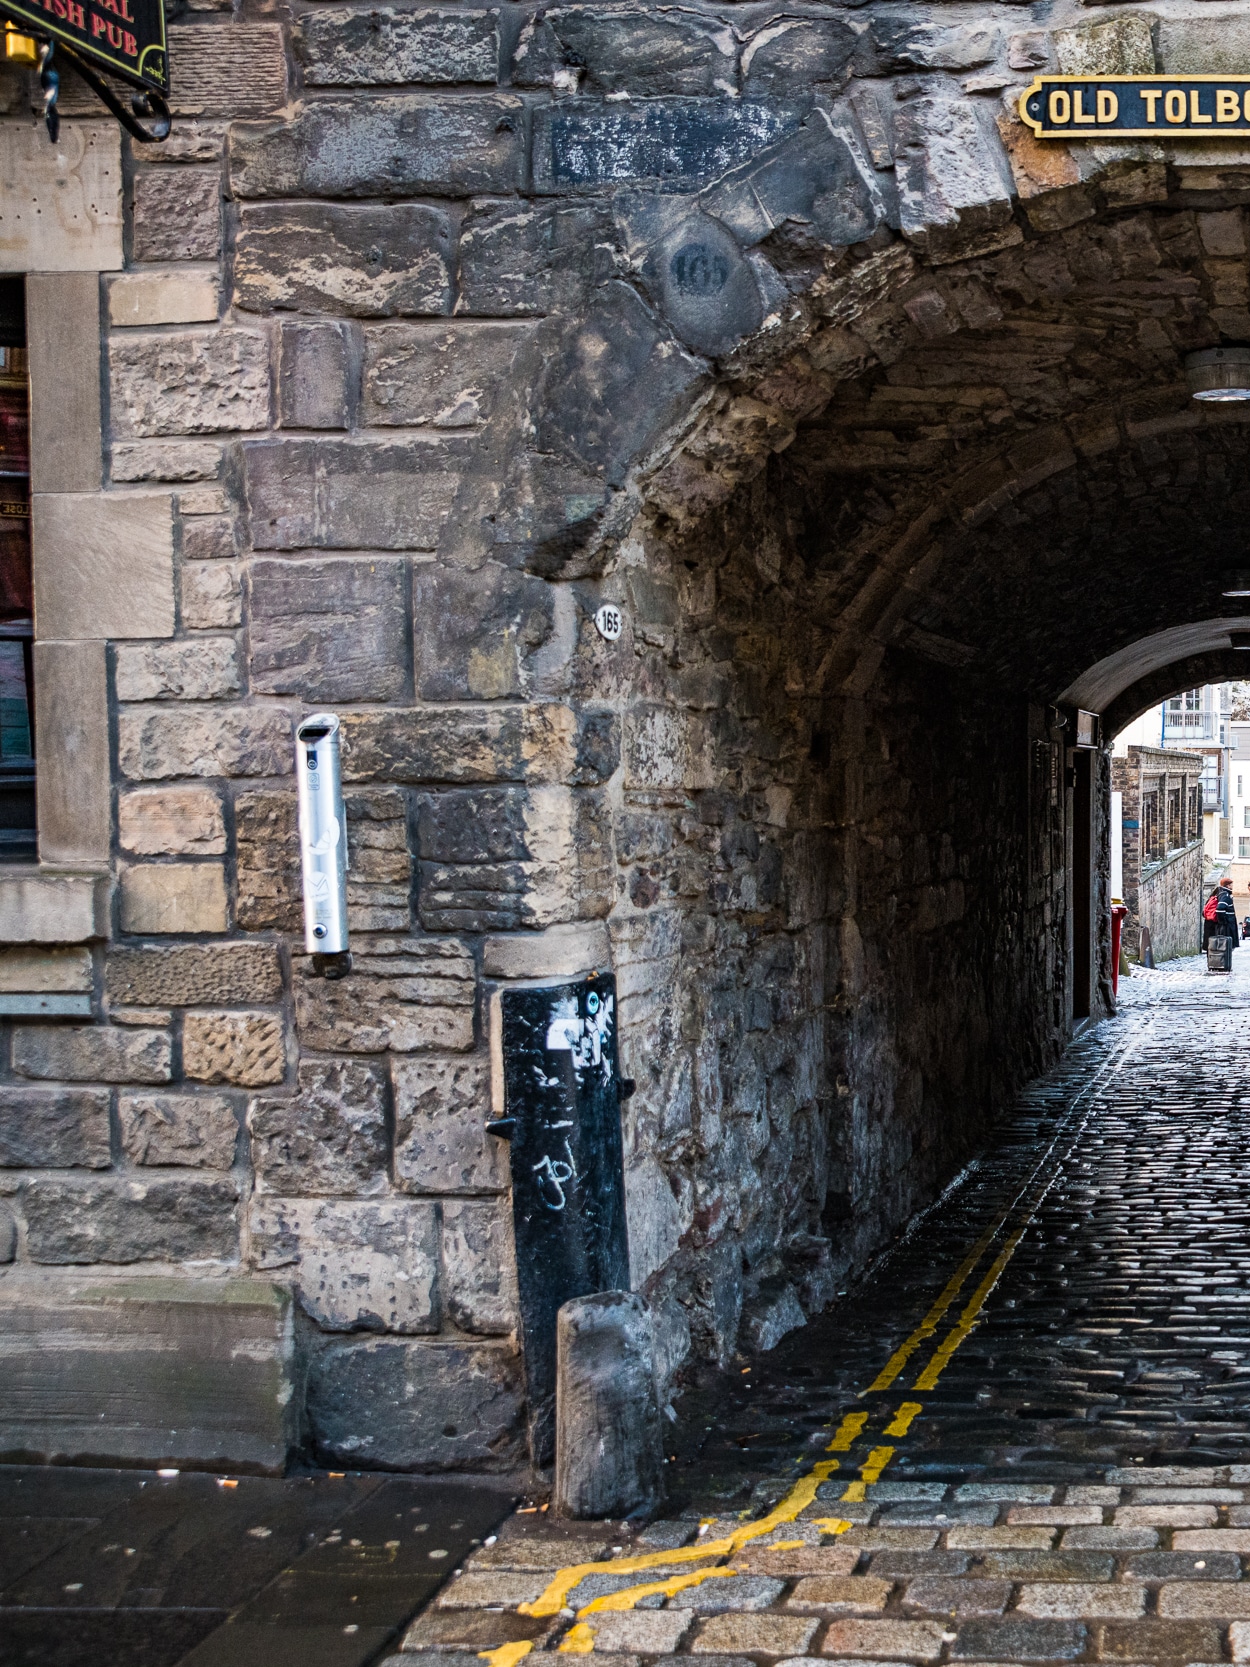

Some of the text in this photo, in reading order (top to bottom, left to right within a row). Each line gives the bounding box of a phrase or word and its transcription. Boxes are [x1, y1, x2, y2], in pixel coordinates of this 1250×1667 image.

[91, 12, 138, 56] PUB
[1049, 89, 1118, 123] OLD
[602, 610, 618, 633] 165
